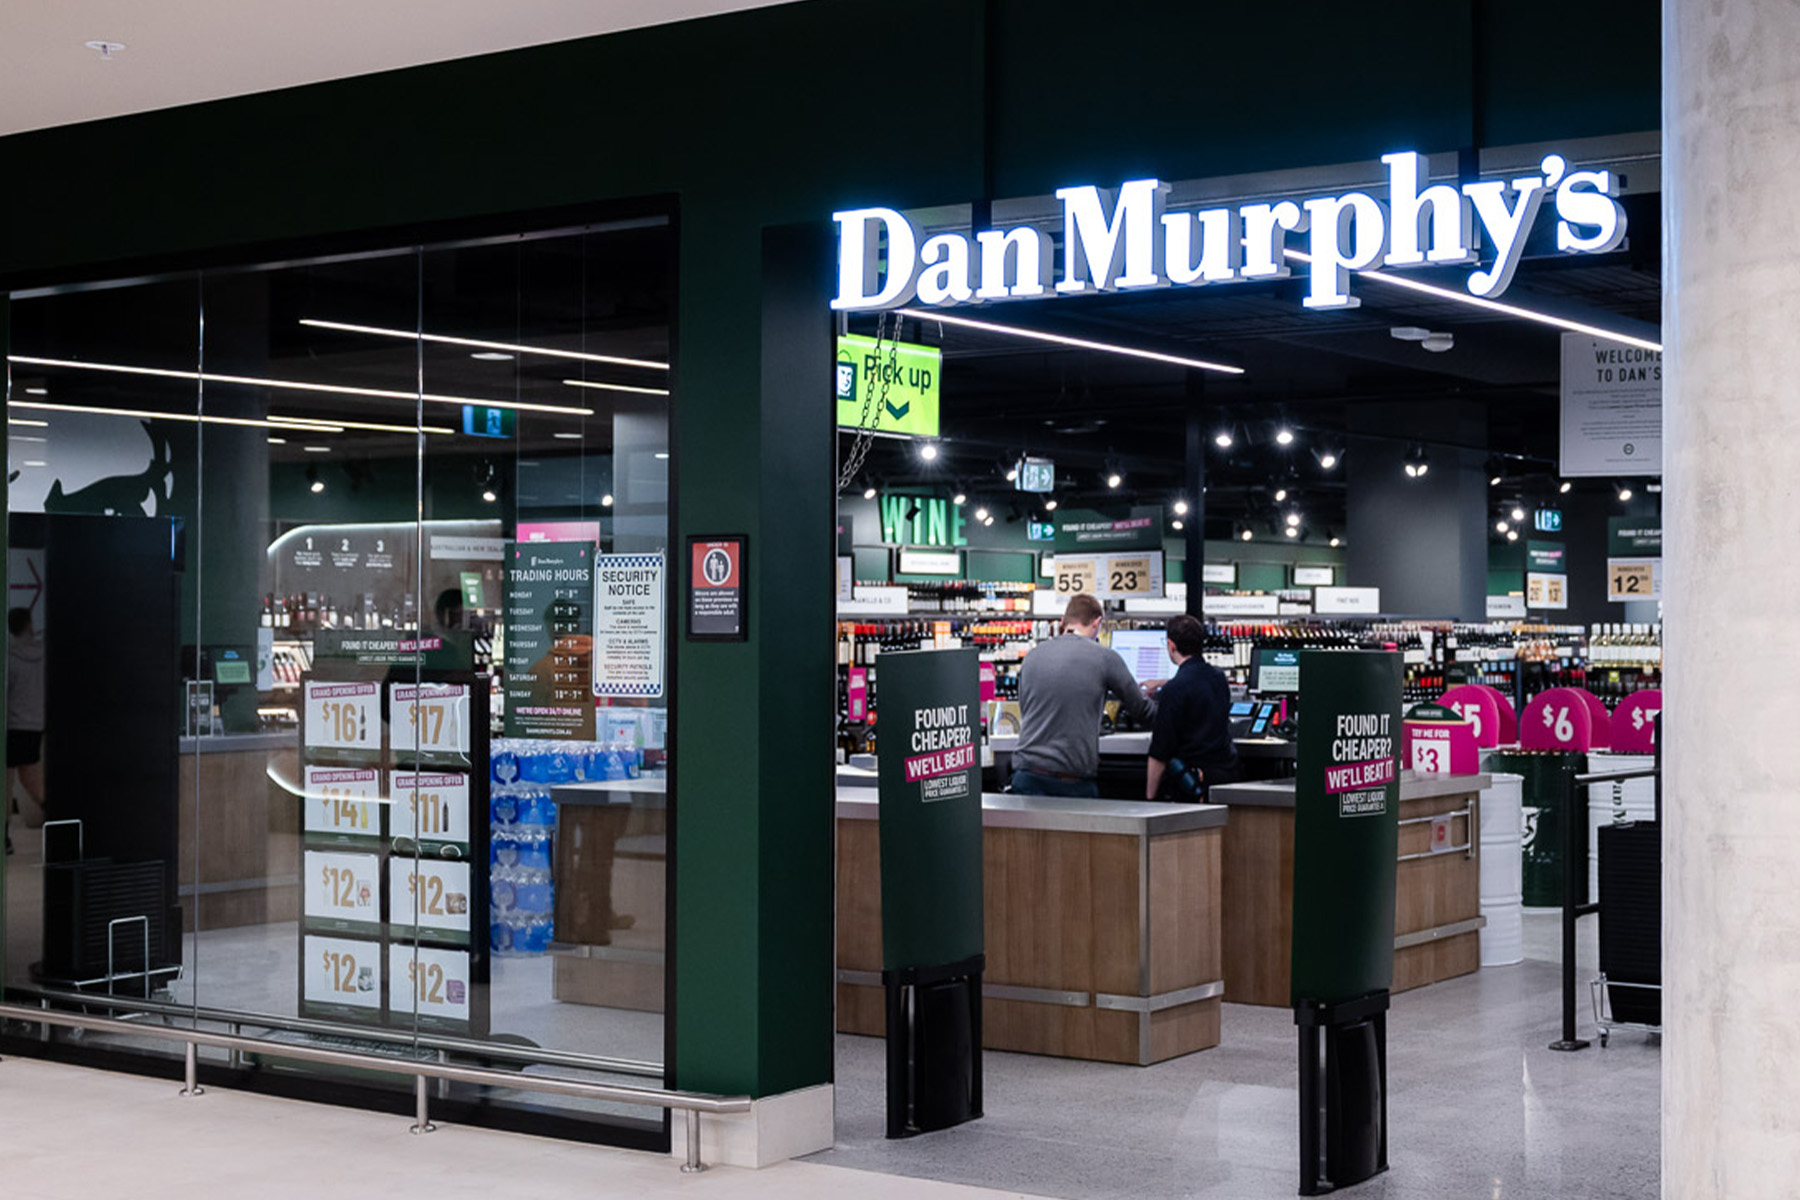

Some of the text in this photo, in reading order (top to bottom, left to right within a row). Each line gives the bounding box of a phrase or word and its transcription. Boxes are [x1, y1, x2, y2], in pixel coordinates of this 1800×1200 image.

[831, 151, 1622, 310] Dan Murphy's
[1595, 348, 1662, 364] WELCOME
[864, 354, 932, 395] Pick up
[1597, 366, 1662, 383] TO DAN'S
[881, 494, 968, 546] WINE
[305, 536, 313, 551] 1
[341, 538, 350, 552] 2
[376, 540, 385, 553] 3
[509, 568, 590, 582] TRADING HOURS
[602, 570, 658, 583] SECURITY
[1058, 573, 1084, 593] 55
[1111, 571, 1138, 591] 23
[608, 584, 651, 596] NOTICE
[1613, 575, 1640, 593] 12
[509, 591, 533, 599] MONDAY
[509, 608, 534, 616] TUESDAY
[509, 624, 543, 632] WEDNESDAY
[341, 640, 361, 651] FOUND
[362, 640, 369, 650] IT
[369, 640, 398, 650] CHEAPER?
[509, 641, 538, 649] THURSDAY
[509, 657, 529, 665] FRIDAY
[509, 674, 538, 682] SATURDAY
[312, 685, 374, 698] GRAND OPENING OFFER
[396, 690, 417, 700] GRAND
[509, 690, 532, 698] SUNDAY
[322, 700, 357, 742] $16
[408, 703, 445, 745] $17
[915, 705, 968, 730] FOUND IT
[1337, 713, 1391, 737] FOUND IT
[1542, 704, 1574, 743] $6
[911, 726, 972, 753] CHEAPER?
[1411, 728, 1450, 738] TRY ME FOR
[1332, 737, 1392, 762] CHEAPER?
[907, 745, 974, 778] WE'LL BEAT IT
[1417, 746, 1439, 773] $3
[312, 770, 373, 783] GRAND OPENING OFFER
[396, 775, 462, 788] GRAND OPENING OFFER
[923, 775, 967, 789] LOWEST LIQUOR
[1328, 760, 1394, 790] WE'LL BEAT IT
[925, 789, 939, 798] PRICE
[1342, 791, 1385, 804] LOWEST LIQUOR
[322, 785, 358, 828] $14
[409, 790, 440, 834] $11
[1342, 804, 1357, 813] PRICE
[322, 864, 355, 908] $12
[408, 872, 445, 915] $12
[322, 949, 357, 993] $12
[408, 959, 445, 1003] $12
